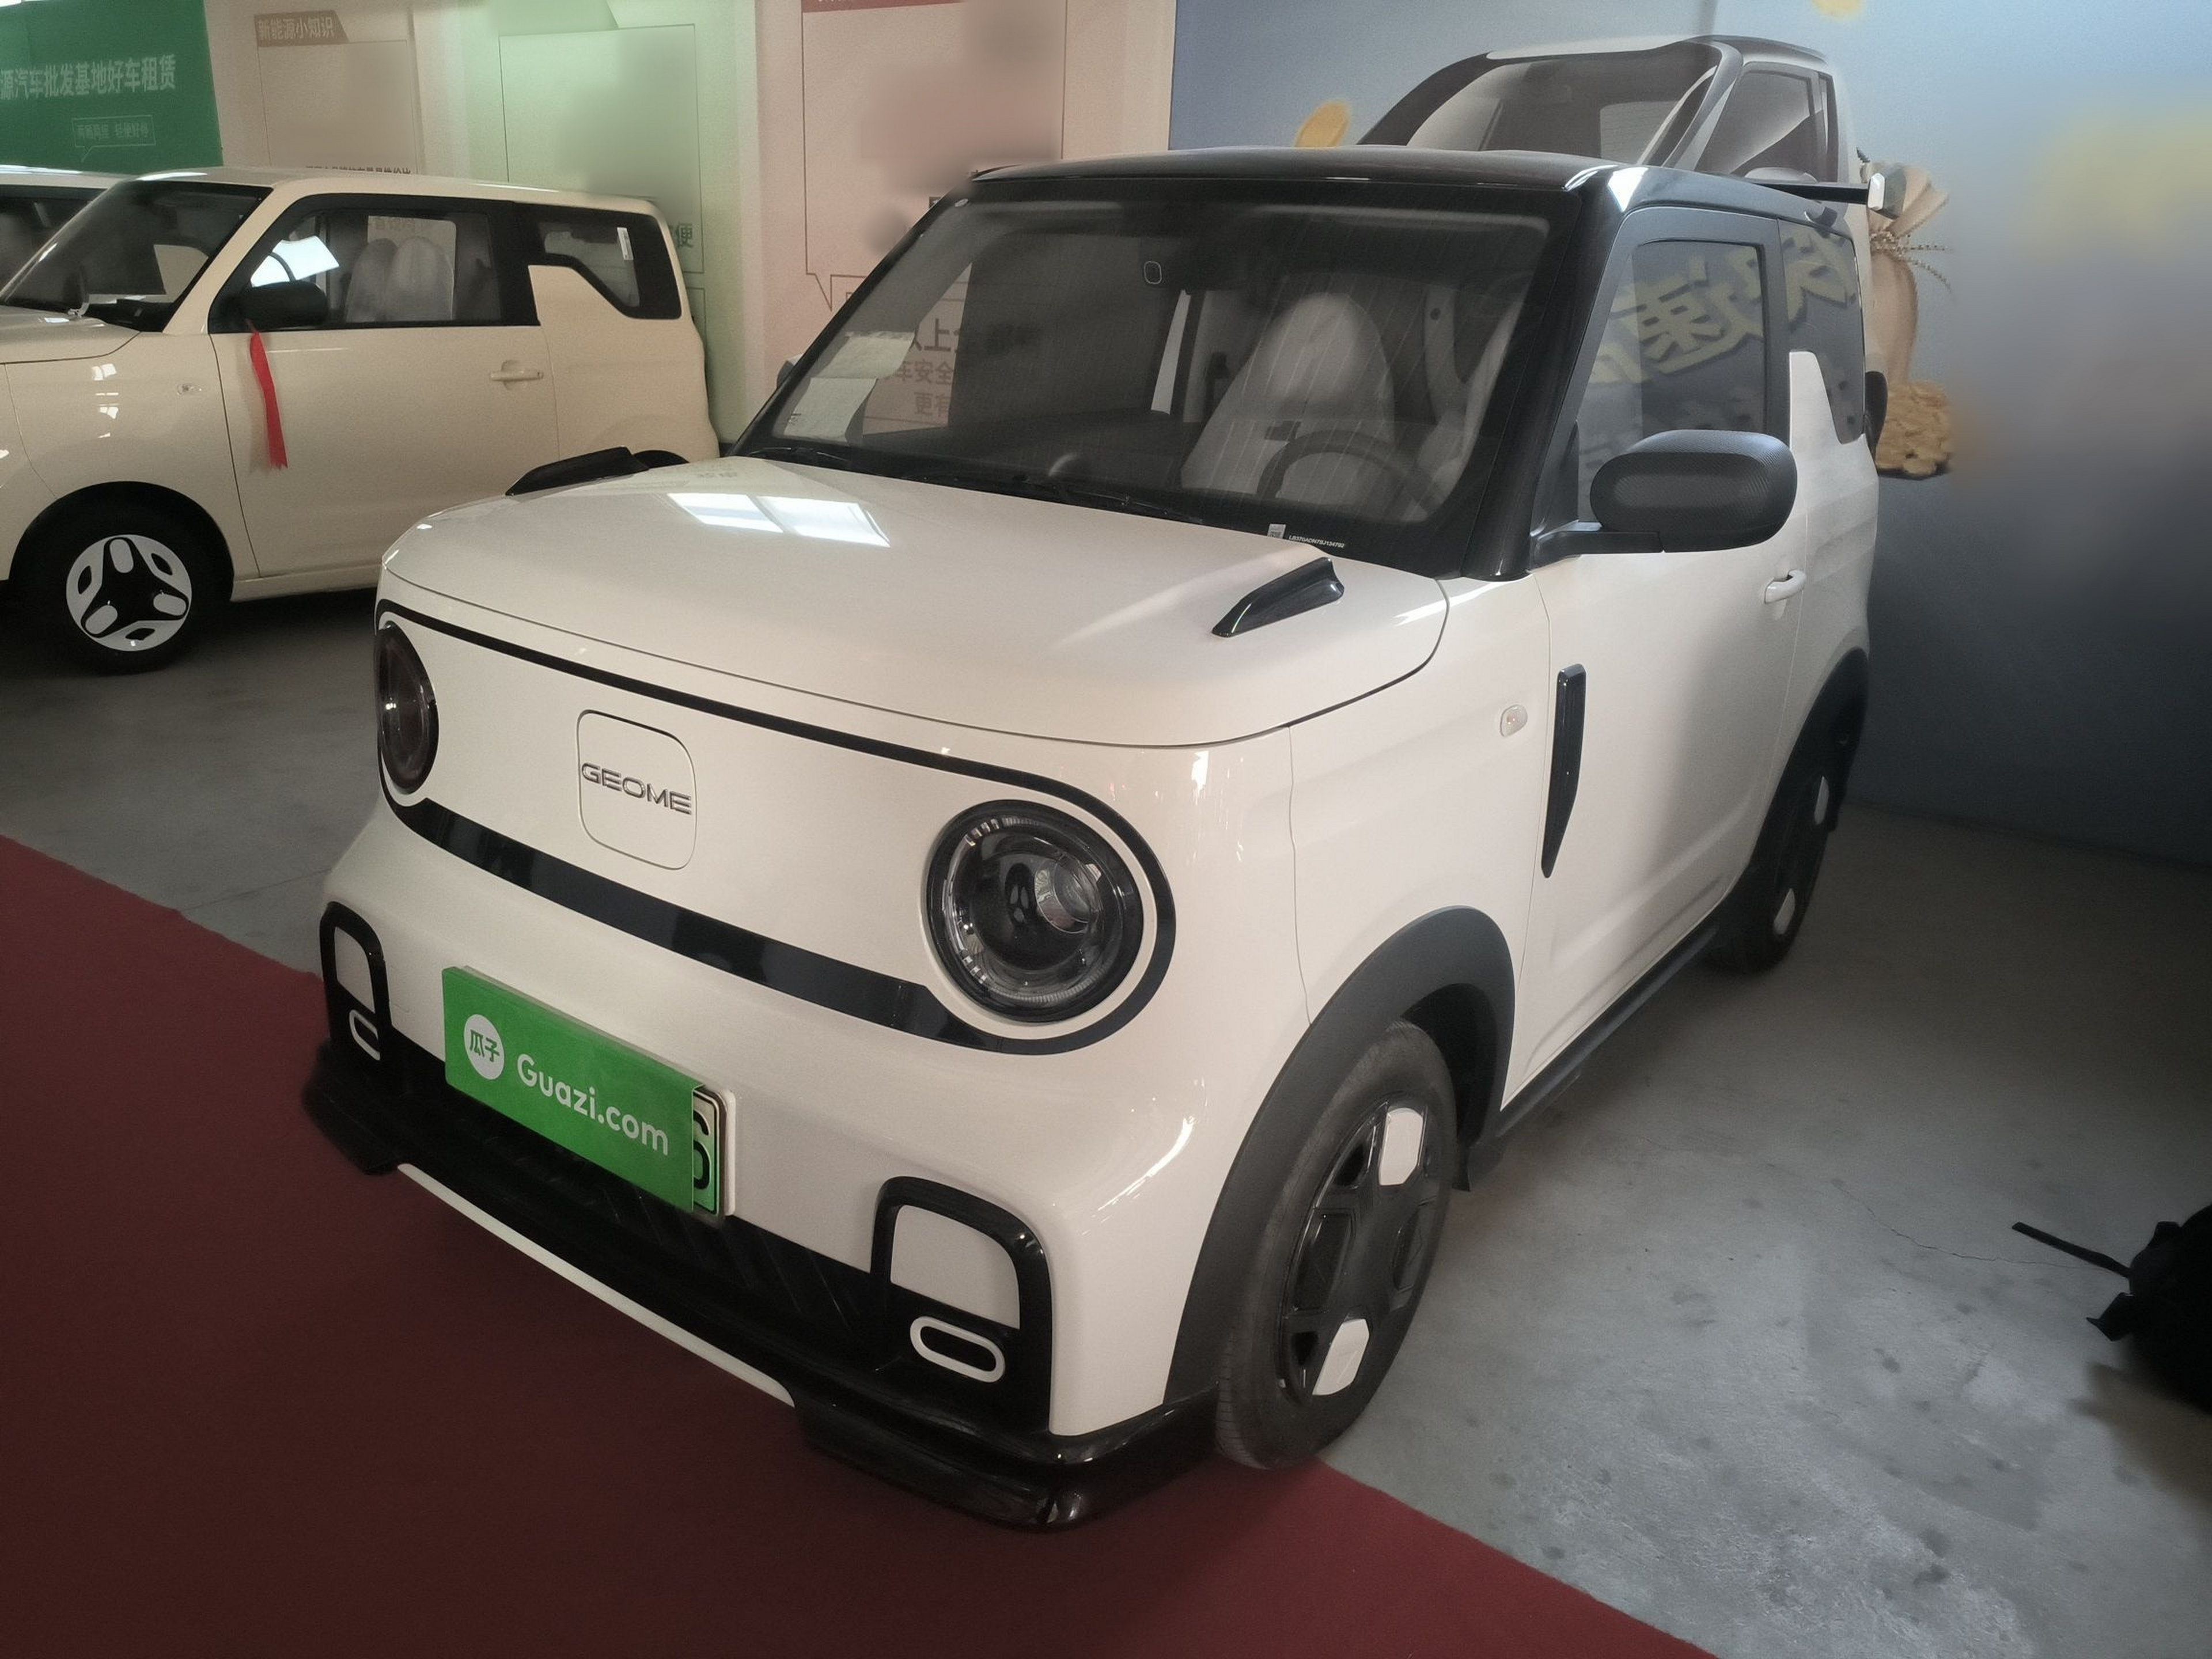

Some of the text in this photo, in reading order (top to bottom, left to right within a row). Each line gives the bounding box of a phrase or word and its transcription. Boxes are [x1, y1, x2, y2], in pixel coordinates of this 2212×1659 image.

[259, 17, 335, 41] 新能源小知识
[0, 54, 176, 100] 源汽车批发基地好车租赁
[581, 762, 692, 815] GEOME
